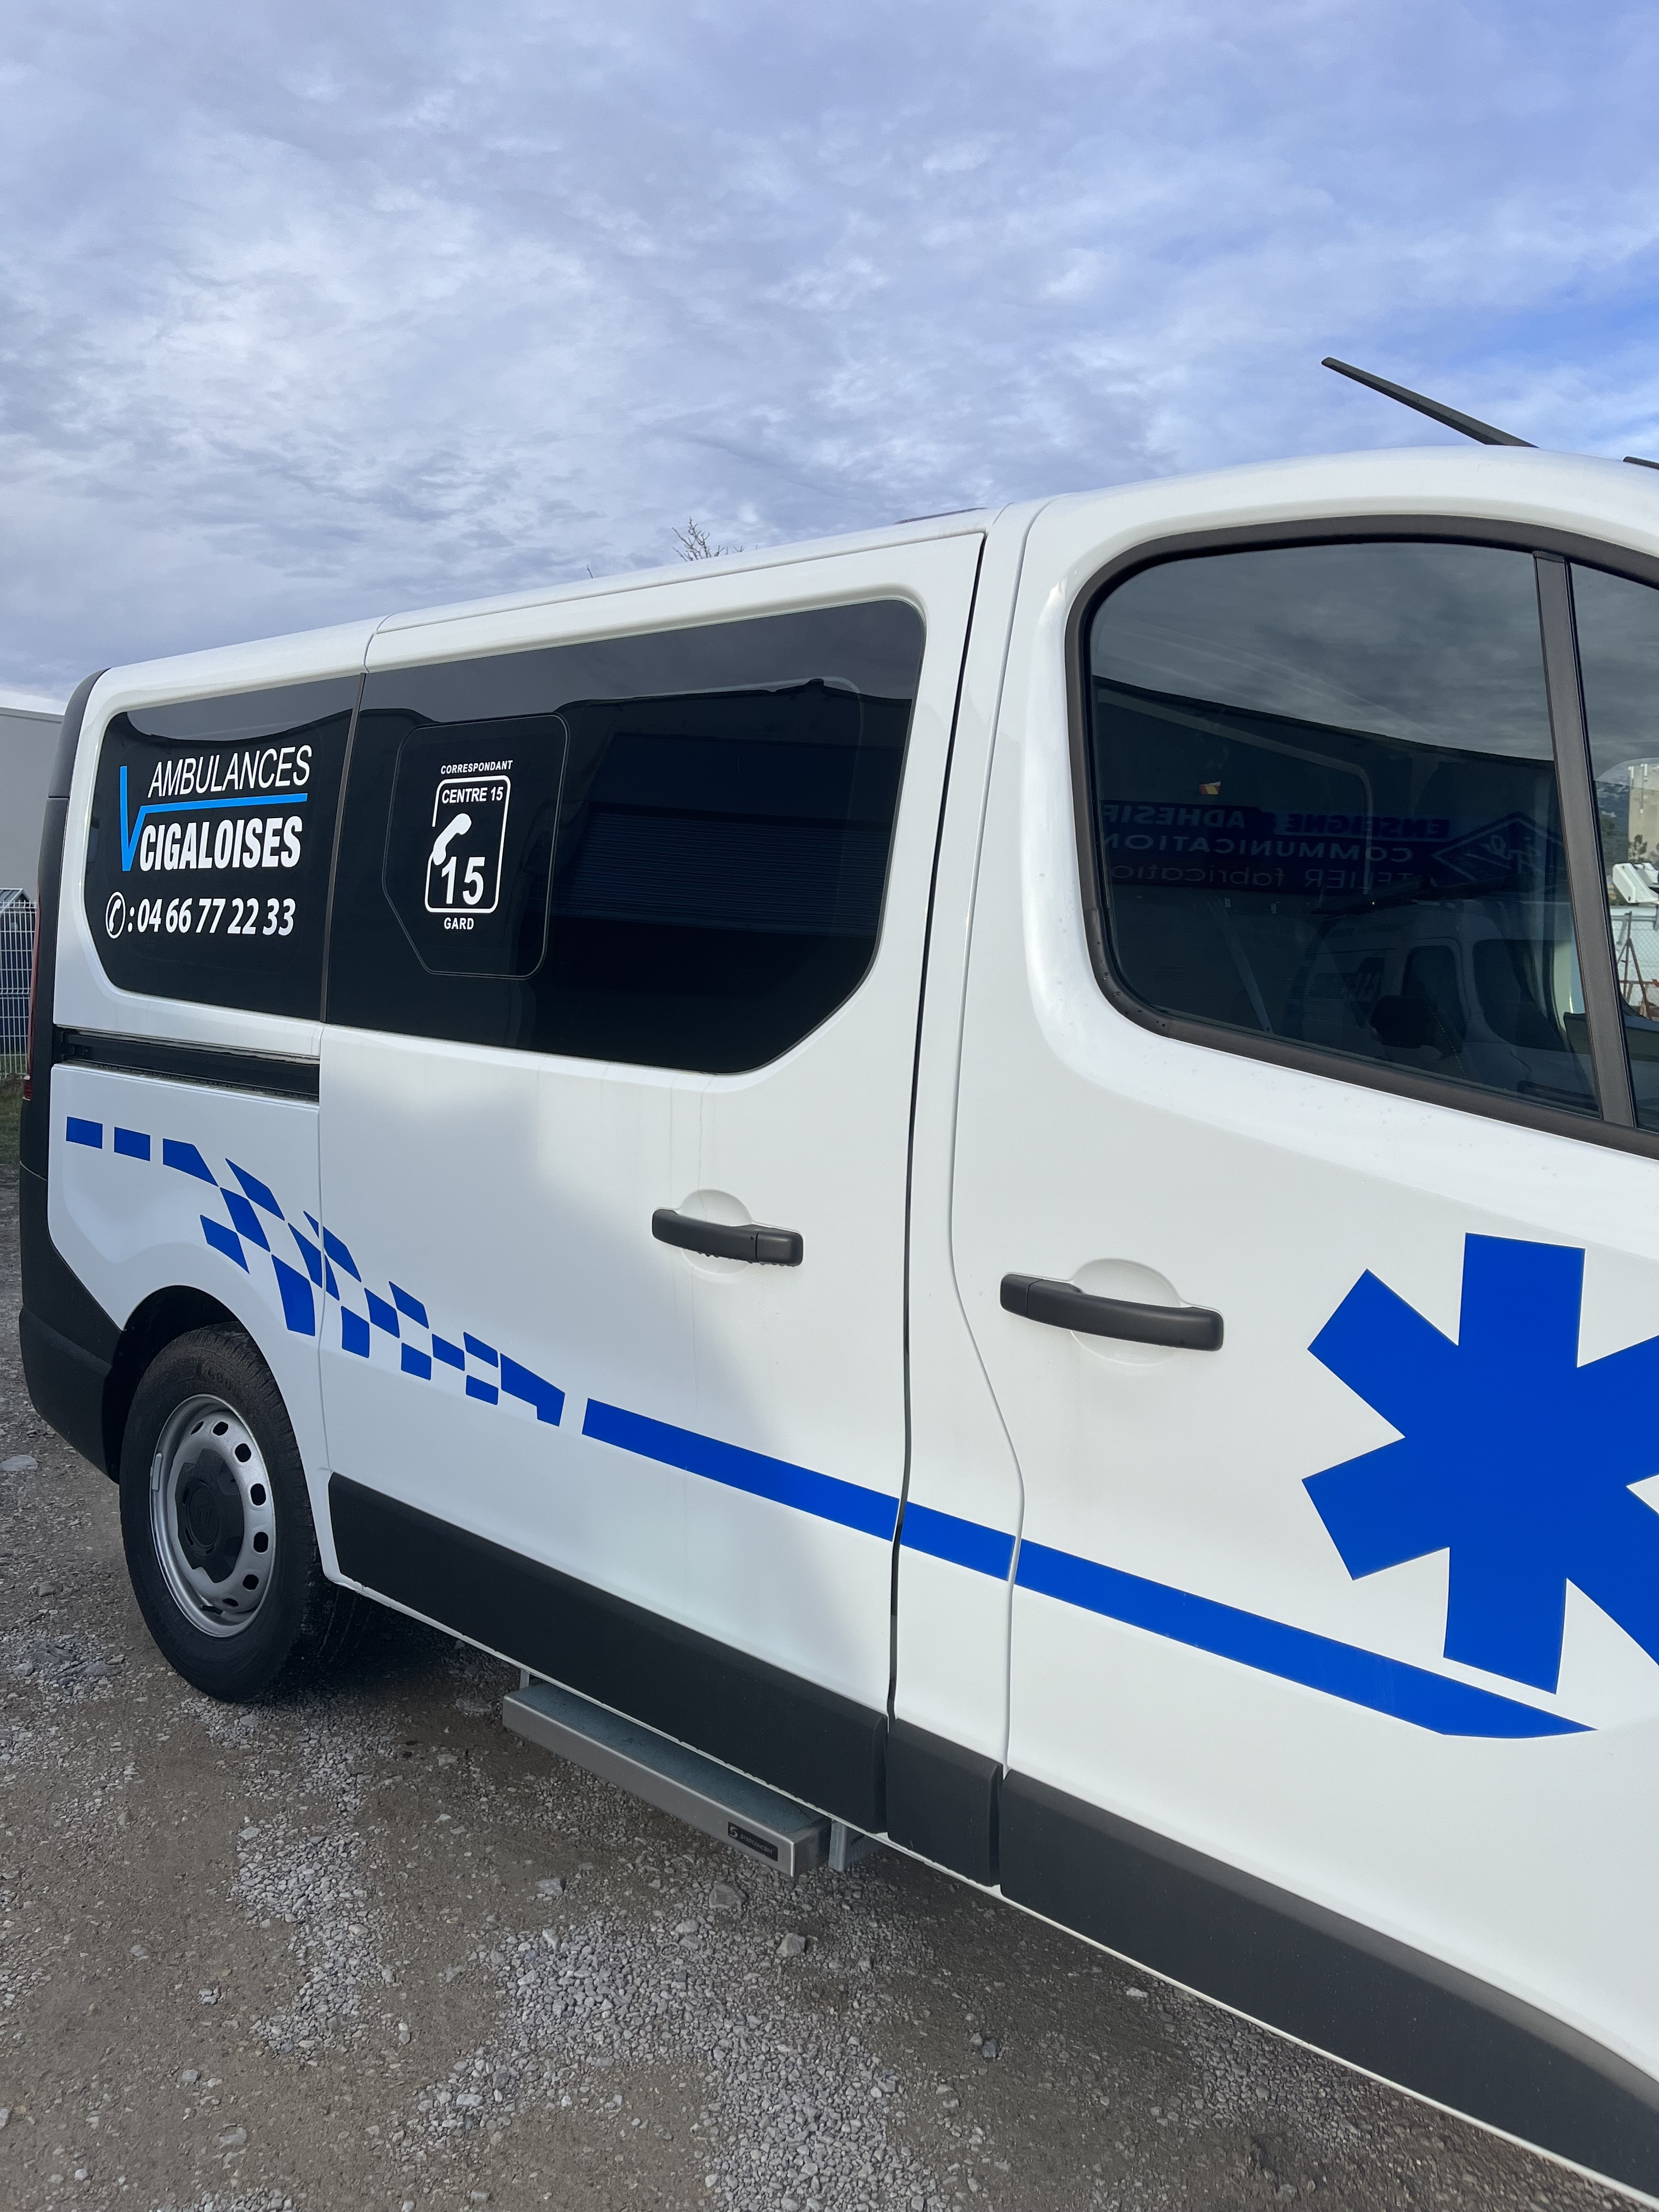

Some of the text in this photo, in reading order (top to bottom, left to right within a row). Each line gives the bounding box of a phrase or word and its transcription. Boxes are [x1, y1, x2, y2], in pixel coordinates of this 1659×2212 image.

[148, 745, 312, 798] AMBULANCES
[441, 760, 513, 774] CORRESPONDANT
[442, 787, 504, 804] CENTRE 15
[140, 816, 303, 871] CIGALOISES
[441, 856, 486, 905] 15
[166, 898, 193, 933] 66
[195, 898, 226, 933] 77
[227, 898, 259, 934] 22
[262, 898, 296, 936] 33
[444, 917, 474, 930] GARD
